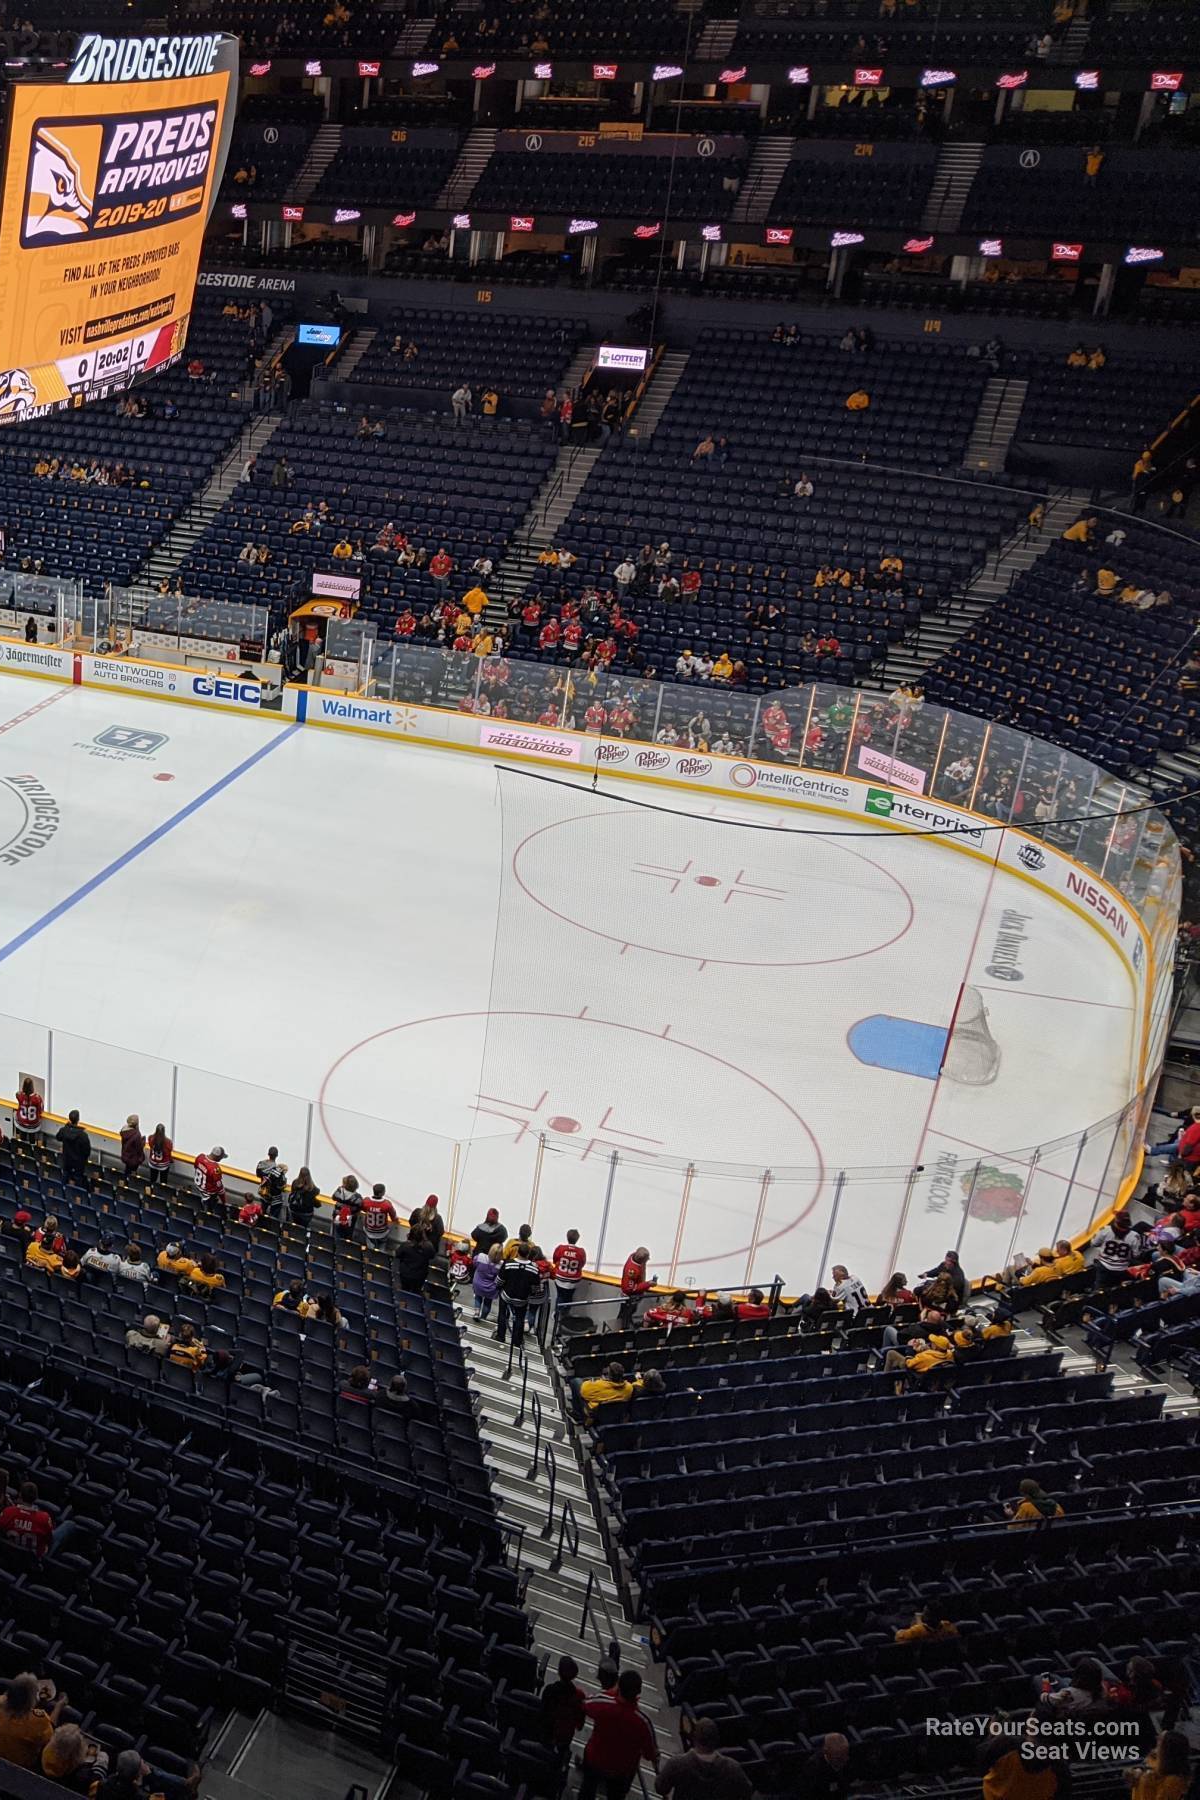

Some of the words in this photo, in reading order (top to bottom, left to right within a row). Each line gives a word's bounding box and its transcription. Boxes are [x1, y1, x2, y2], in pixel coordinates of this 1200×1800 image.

[67, 33, 222, 83] BRIDGESTONE
[104, 110, 216, 163] PREDS
[578, 135, 596, 147] 215
[98, 150, 209, 195] APPROVED
[93, 197, 167, 229] 2019-20
[63, 267, 81, 282] FIND
[83, 263, 95, 279] ALL
[98, 261, 107, 276] OF
[109, 259, 121, 274] THE
[122, 254, 141, 271] PREDS
[90, 285, 98, 299] IN
[100, 280, 116, 297] YOUR
[257, 278, 296, 291] ARENA
[60, 326, 83, 346] VISIT
[78, 358, 88, 378] 0
[98, 346, 129, 370] 20:02
[136, 340, 145, 358] 0
[611, 353, 644, 363] LOTTERY
[19, 404, 51, 422] NCAAF
[86, 389, 99, 402] VAN
[93, 660, 164, 680] BRENTWOOD
[93, 669, 118, 681] AUTO
[120, 674, 164, 688] BROKERS
[192, 677, 261, 704] GEIC
[322, 698, 393, 725] Walmart
[487, 734, 573, 757] PREDATORS
[600, 746, 627, 761] Pepper
[88, 751, 128, 762] BANK
[639, 752, 668, 768] Pepper
[680, 758, 710, 775] Pepper
[757, 769, 849, 797] IntelliCentrics
[873, 795, 982, 839] enterprise
[1017, 845, 1046, 867] NHL
[1066, 872, 1128, 938] NISSAN
[194, 1170, 207, 1190] 81
[366, 1213, 386, 1227] 88
[1104, 1240, 1130, 1259] 88
